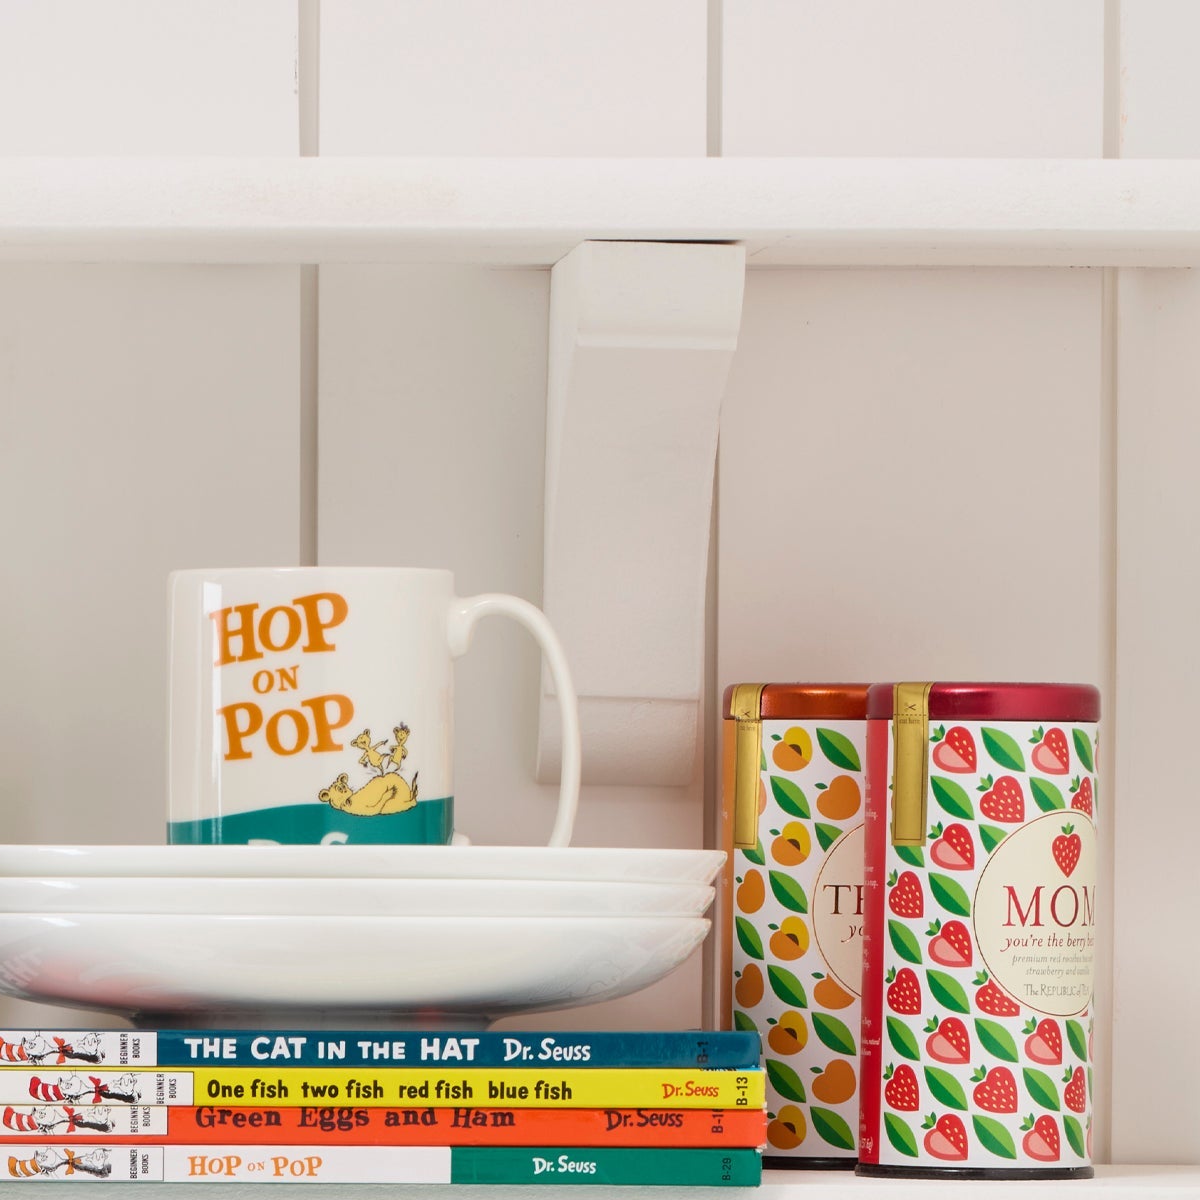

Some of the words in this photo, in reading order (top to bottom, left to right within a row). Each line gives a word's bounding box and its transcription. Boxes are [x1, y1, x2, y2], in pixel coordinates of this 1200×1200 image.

[209, 592, 348, 667] HOP
[252, 665, 299, 694] ON
[216, 694, 355, 761] POP
[1002, 885, 1096, 928] MOM
[999, 934, 1043, 952] you're
[1047, 933, 1064, 948] the
[1011, 953, 1048, 967] premium
[1025, 965, 1065, 978] strawberry
[1024, 984, 1039, 996] The
[120, 1033, 128, 1064] BEGINNER
[132, 1038, 140, 1059] BOOKS
[184, 1038, 237, 1059] THE
[250, 1036, 307, 1060] CAT
[318, 1041, 346, 1060] IN
[357, 1041, 406, 1060] THE
[420, 1038, 480, 1061] HAT
[503, 1038, 534, 1061] Dr.
[538, 1037, 591, 1061] Seuss
[156, 1073, 164, 1104] BEGINNER
[169, 1078, 177, 1099] BOOKS
[207, 1079, 245, 1098] One
[250, 1078, 289, 1098] fish
[301, 1081, 339, 1098] two
[345, 1079, 384, 1099] fish
[398, 1080, 429, 1099] red
[434, 1079, 473, 1099] fish
[488, 1081, 529, 1100] blue
[534, 1081, 572, 1100] fish
[662, 1083, 683, 1099] Dr.
[685, 1081, 719, 1098] Seuss
[736, 1076, 748, 1106] B-13
[143, 1106, 151, 1127] BOOKS
[195, 1106, 282, 1128] Green
[297, 1107, 370, 1132] Eggs
[384, 1107, 438, 1127] and
[450, 1107, 516, 1128] Ham
[604, 1109, 634, 1131] Dr.
[636, 1108, 684, 1128] Seuss
[187, 1155, 242, 1176] HOP
[247, 1162, 265, 1172] ON
[271, 1156, 323, 1177] POP
[532, 1157, 555, 1174] Dr.
[557, 1155, 597, 1174] Seuss
[722, 1157, 732, 1181] B-29
